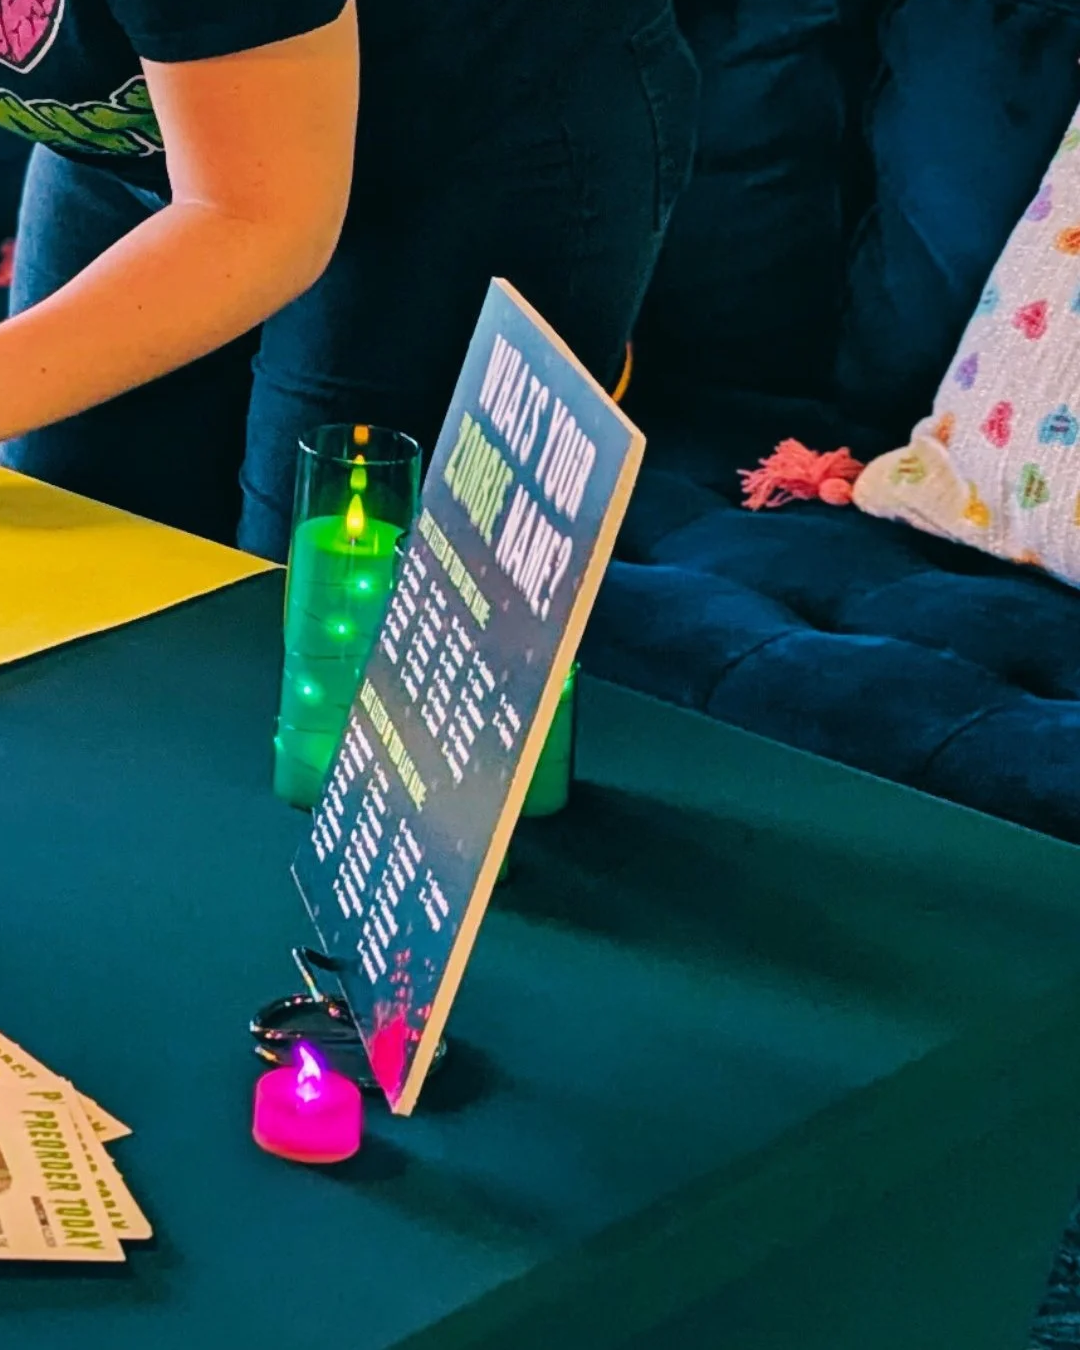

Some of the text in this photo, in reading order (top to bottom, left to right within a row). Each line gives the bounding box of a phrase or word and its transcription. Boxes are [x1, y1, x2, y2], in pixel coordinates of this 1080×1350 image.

[535, 397, 597, 523] YOUR
[444, 411, 513, 547] ZOMBIE
[495, 483, 573, 622] NAME?
[20, 1110, 81, 1192] PREORDER
[48, 1198, 105, 1250] TODAY
